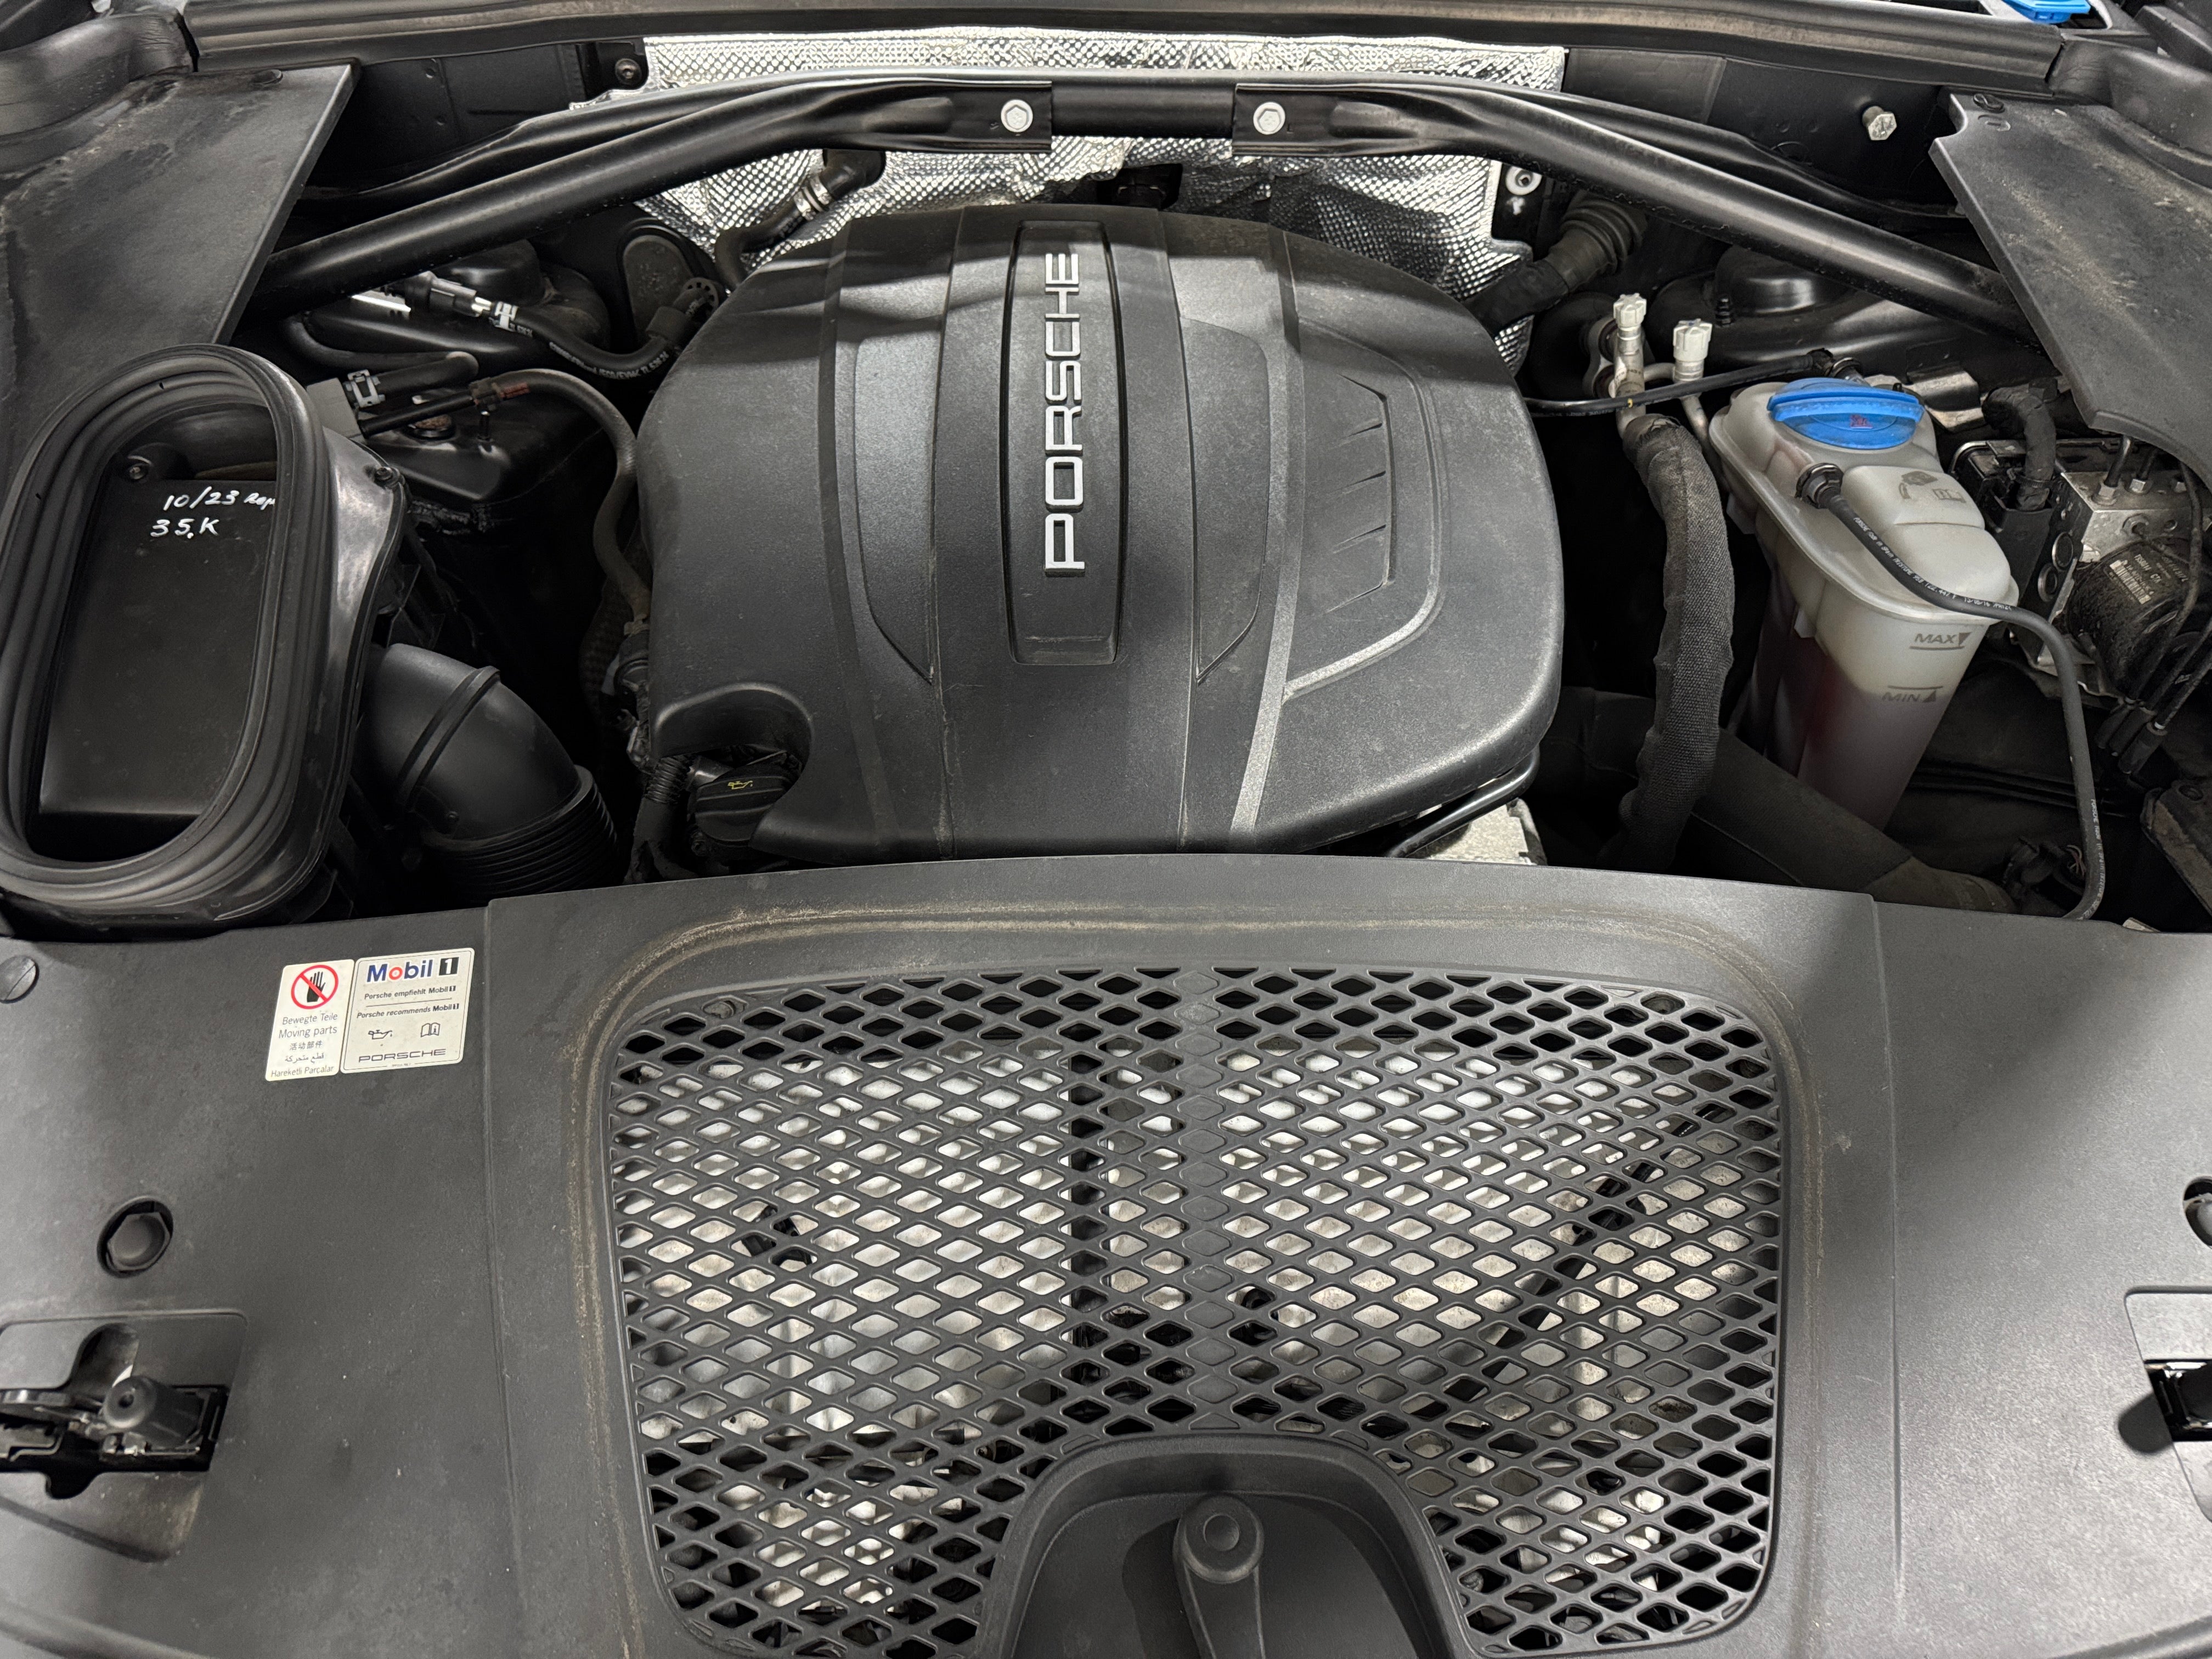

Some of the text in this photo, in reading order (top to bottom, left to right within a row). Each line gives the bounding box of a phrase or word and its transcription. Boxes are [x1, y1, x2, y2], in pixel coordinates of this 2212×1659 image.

[1045, 253, 1086, 574] PORSCHE
[163, 486, 239, 511] 10/23
[1914, 633, 1956, 644] MAX
[1882, 691, 1921, 702] MIN
[366, 959, 433, 983] Mobil
[394, 988, 426, 997] empfiehlt
[386, 1007, 431, 1017] recommends
[282, 1013, 338, 1025] Bewegte Teile
[279, 1026, 338, 1039] Moving parts
[289, 1040, 323, 1051] 活动部件
[358, 1048, 447, 1063] PORSCHE
[270, 1065, 335, 1078] Hareketli Parçalar
